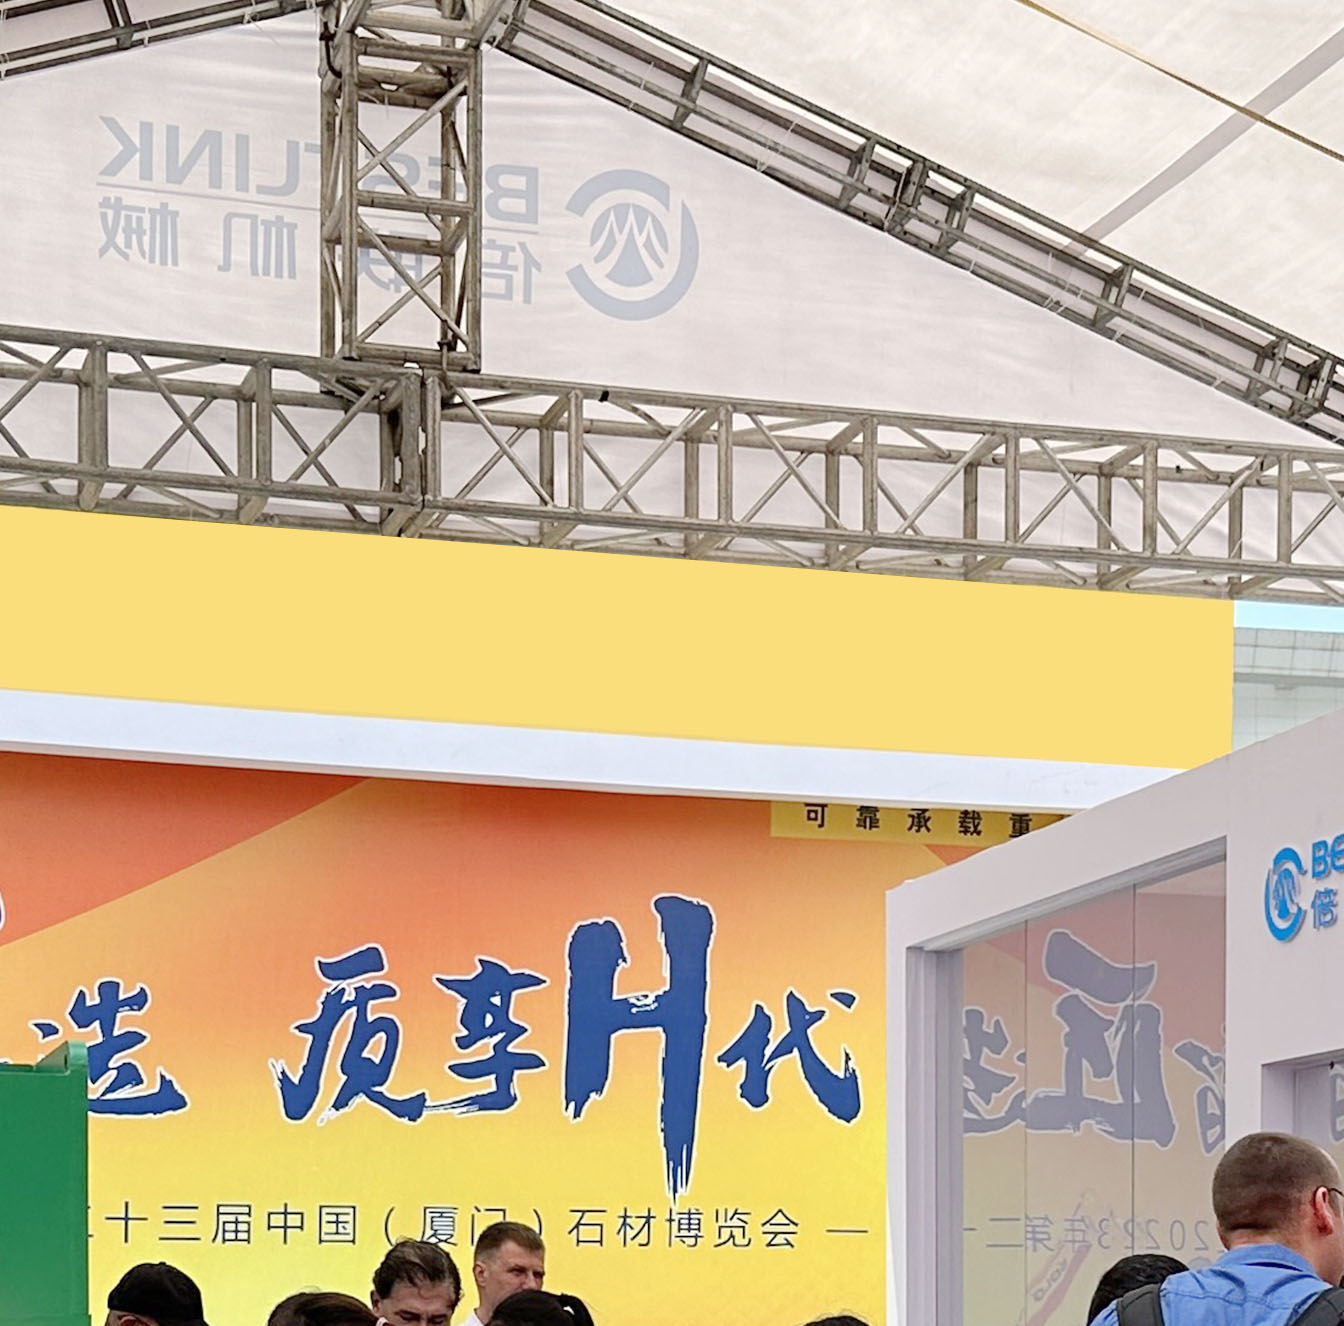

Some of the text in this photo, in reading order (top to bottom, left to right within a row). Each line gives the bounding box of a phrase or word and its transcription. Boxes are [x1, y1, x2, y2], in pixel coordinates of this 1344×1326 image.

[804, 802, 1072, 838] 可靠承载重
[88, 1201, 799, 1250] 十三届中国（厦门）石材博览会
